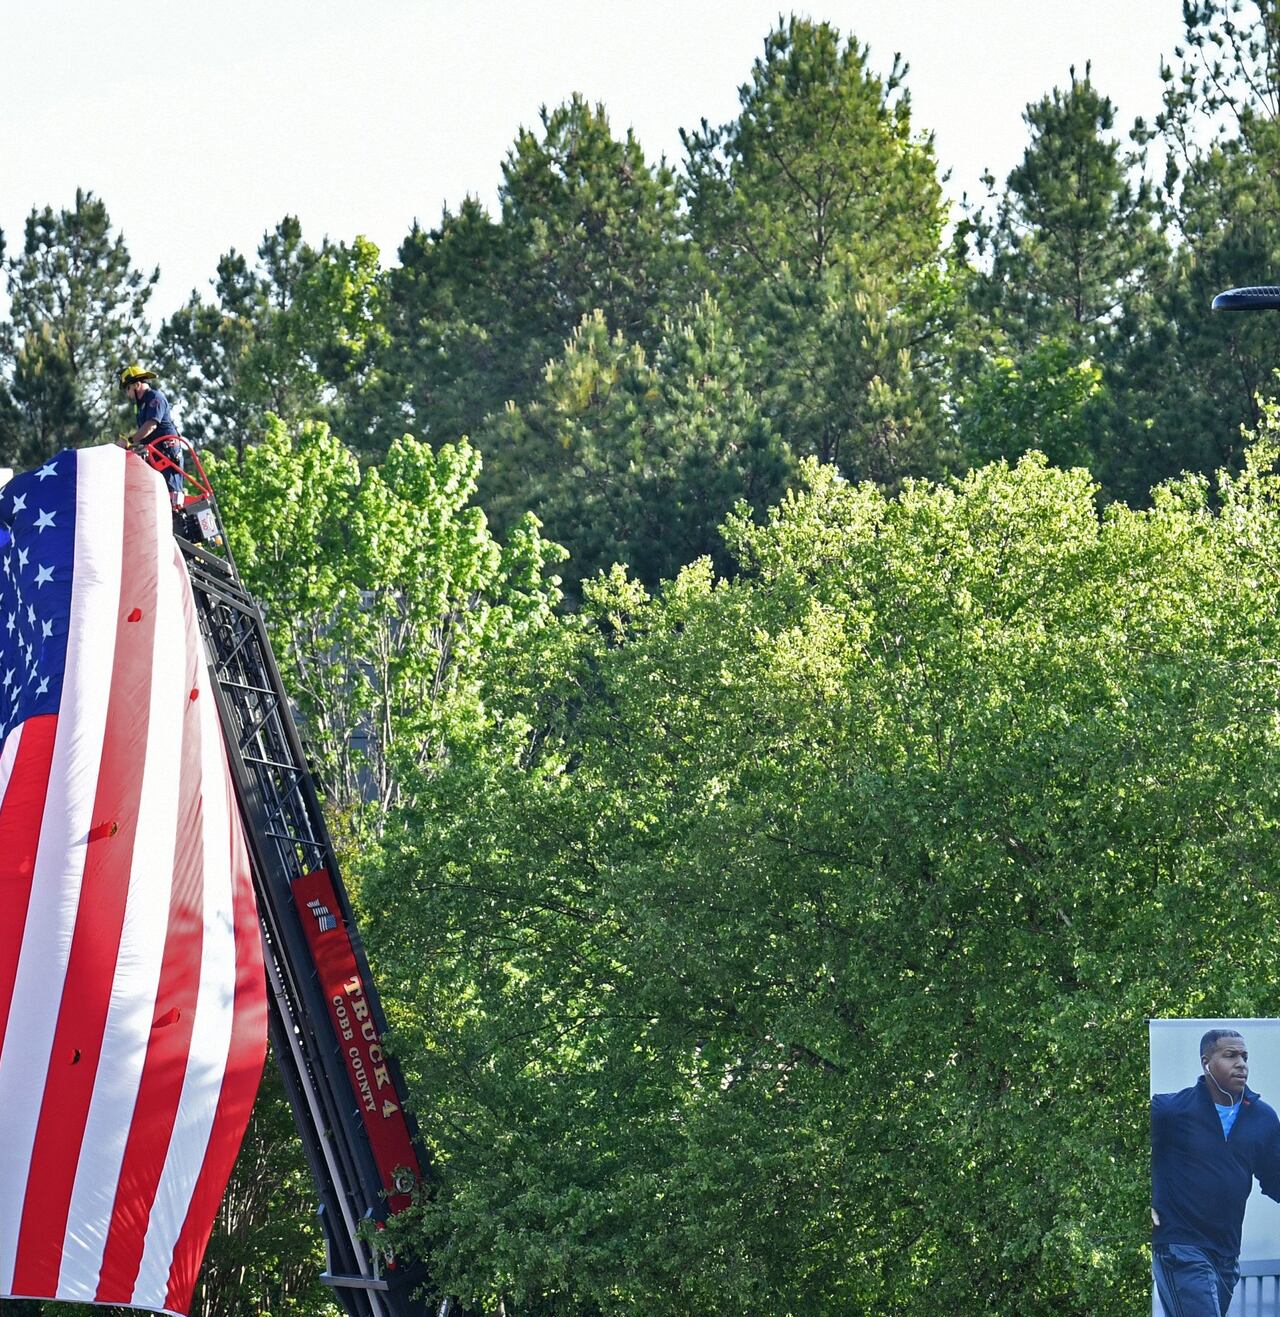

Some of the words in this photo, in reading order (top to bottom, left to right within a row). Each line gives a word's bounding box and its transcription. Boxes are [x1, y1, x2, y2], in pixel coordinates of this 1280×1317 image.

[332, 995, 353, 1041] COBB
[348, 1046, 377, 1113] COUNTY
[343, 975, 391, 1090] TRUCK
[381, 1100, 400, 1118] 4
